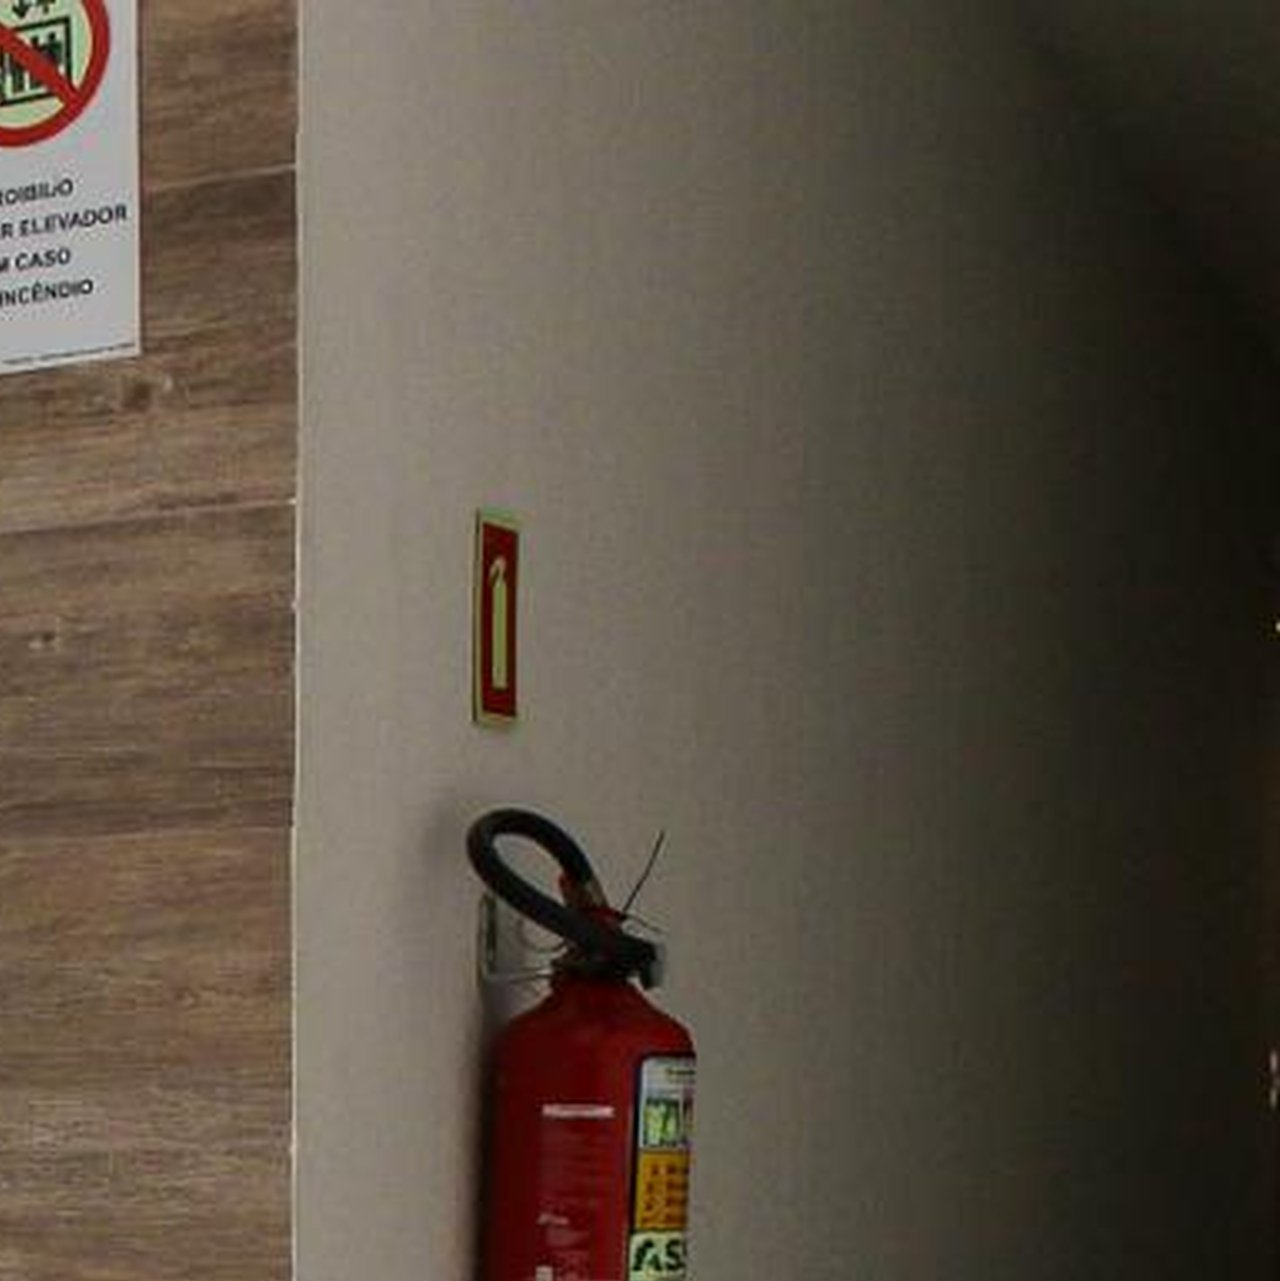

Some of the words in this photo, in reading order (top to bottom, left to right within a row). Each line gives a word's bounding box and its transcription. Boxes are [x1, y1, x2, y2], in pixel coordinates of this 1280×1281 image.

[18, 203, 127, 237] ELEVADOR
[15, 248, 71, 271] CASO
[632, 1238, 687, 1271] AS
